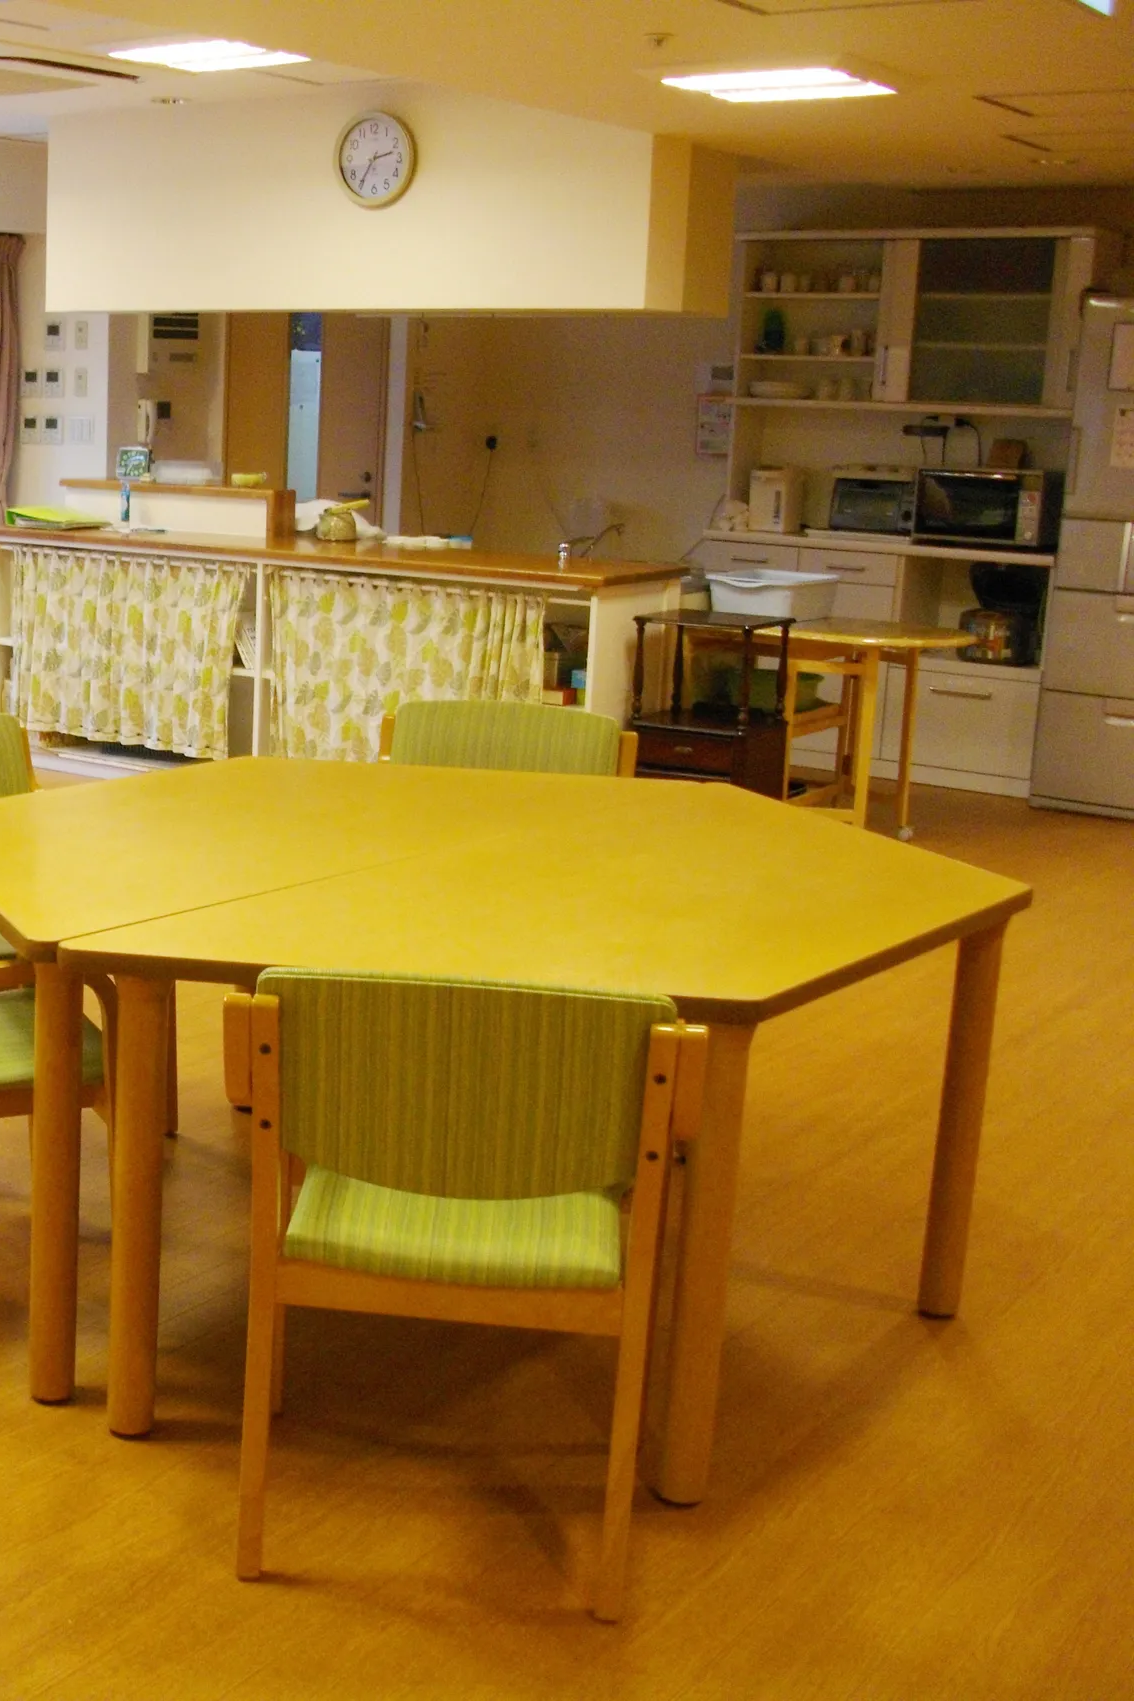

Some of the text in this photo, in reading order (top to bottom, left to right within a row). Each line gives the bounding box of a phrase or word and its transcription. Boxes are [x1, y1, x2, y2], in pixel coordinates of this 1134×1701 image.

[359, 127, 366, 139] 11
[370, 123, 379, 134] 12
[350, 139, 359, 151] 10
[392, 137, 399, 149] 2
[396, 152, 403, 164] 3
[350, 169, 357, 181] 8
[392, 167, 399, 178] 4
[371, 183, 378, 195] 6
[383, 178, 390, 190] 5
